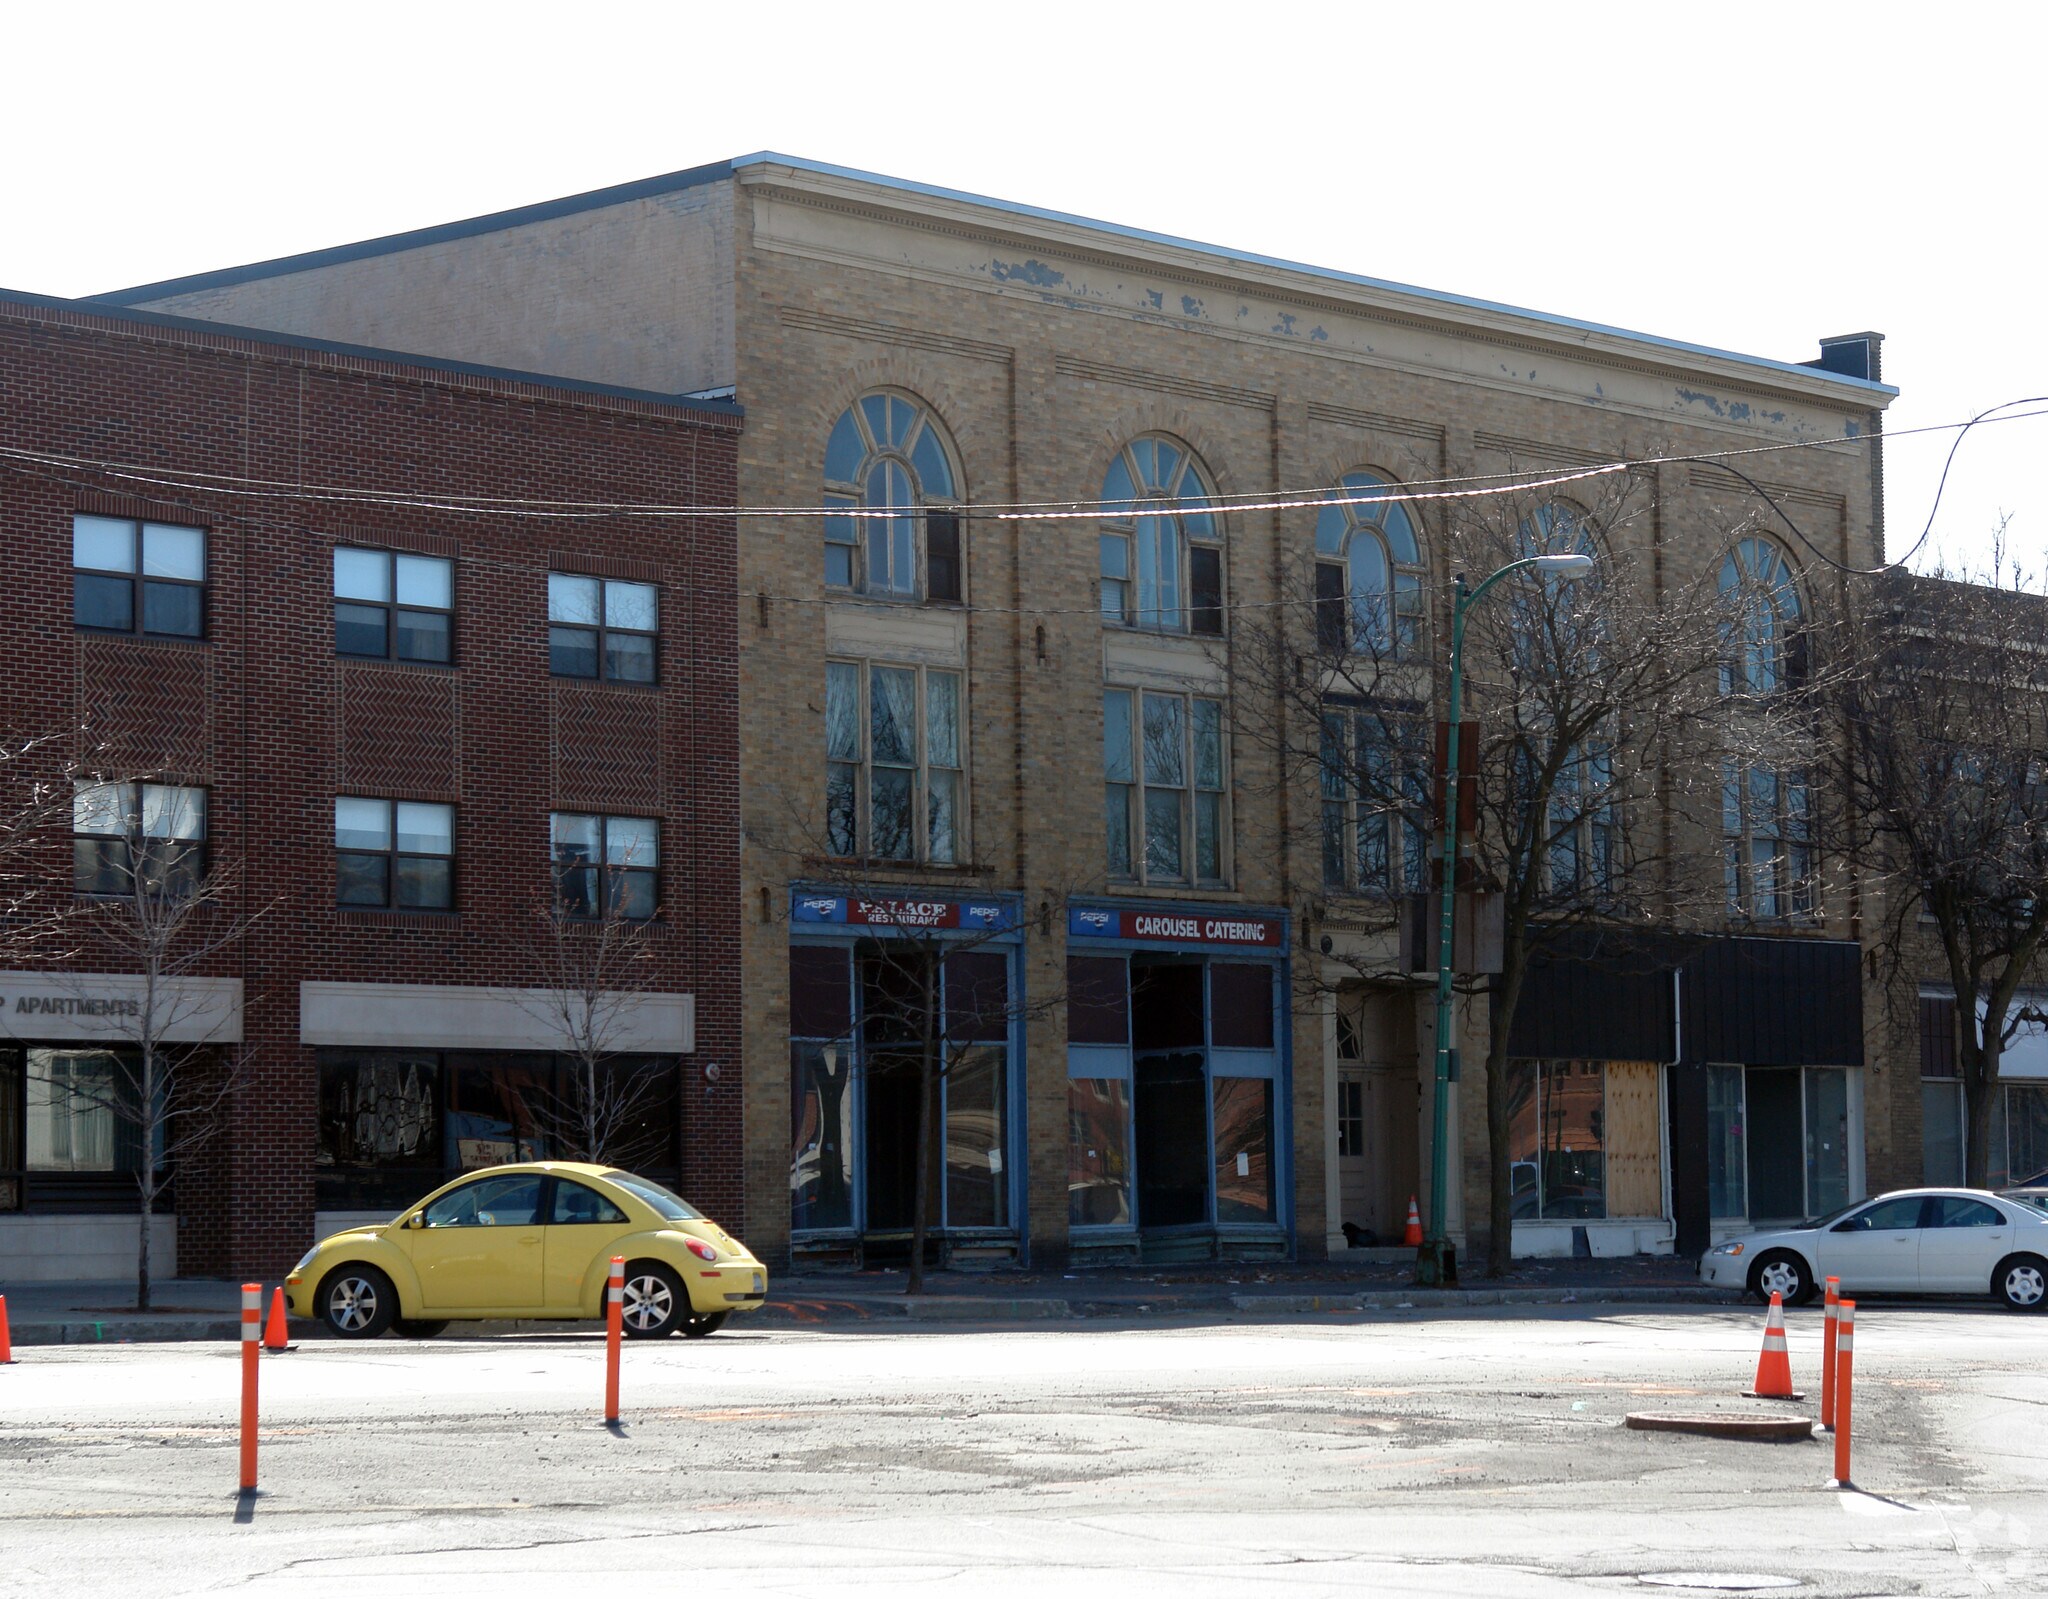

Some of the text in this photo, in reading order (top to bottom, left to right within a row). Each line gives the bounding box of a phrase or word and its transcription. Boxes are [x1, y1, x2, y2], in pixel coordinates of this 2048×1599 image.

[803, 898, 837, 910] PEPSI
[858, 900, 947, 917] PALACE
[969, 906, 999, 917] PEPSI
[1080, 911, 1109, 923] PEPSI
[1135, 916, 1265, 942] CAROUSEL CATERING
[15, 996, 139, 1017] APARTMENTS
